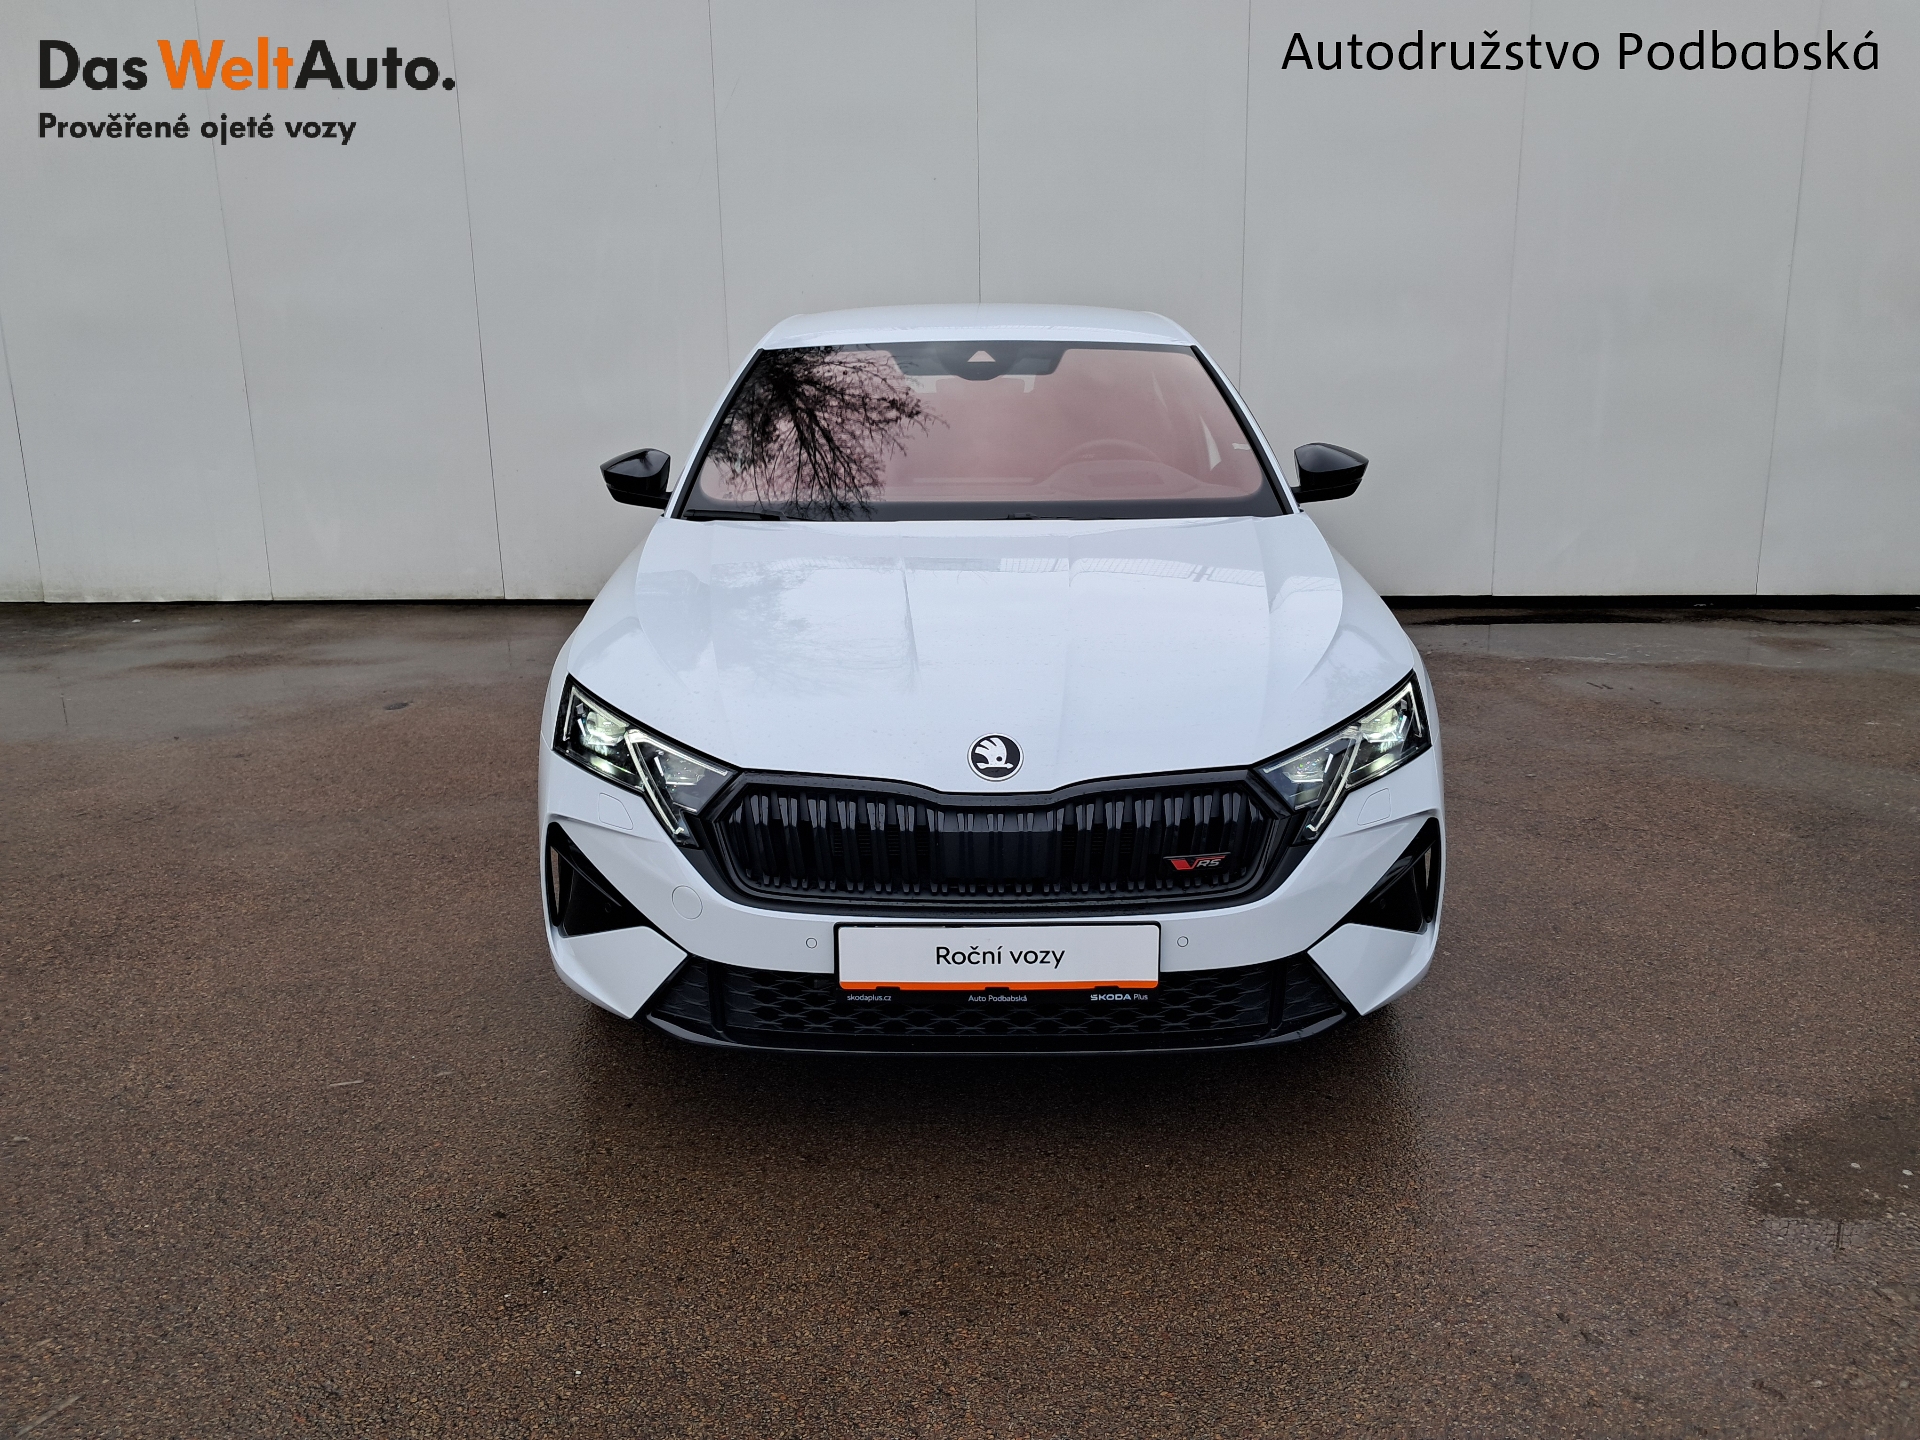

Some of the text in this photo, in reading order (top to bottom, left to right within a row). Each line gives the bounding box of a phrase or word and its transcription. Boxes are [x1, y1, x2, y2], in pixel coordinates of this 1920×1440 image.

[935, 945, 1066, 970] Roční vozy
[847, 993, 892, 1003] skodaplus.cz
[968, 994, 1028, 1002] Auto Podbabská
[1133, 993, 1149, 1001] Plus
